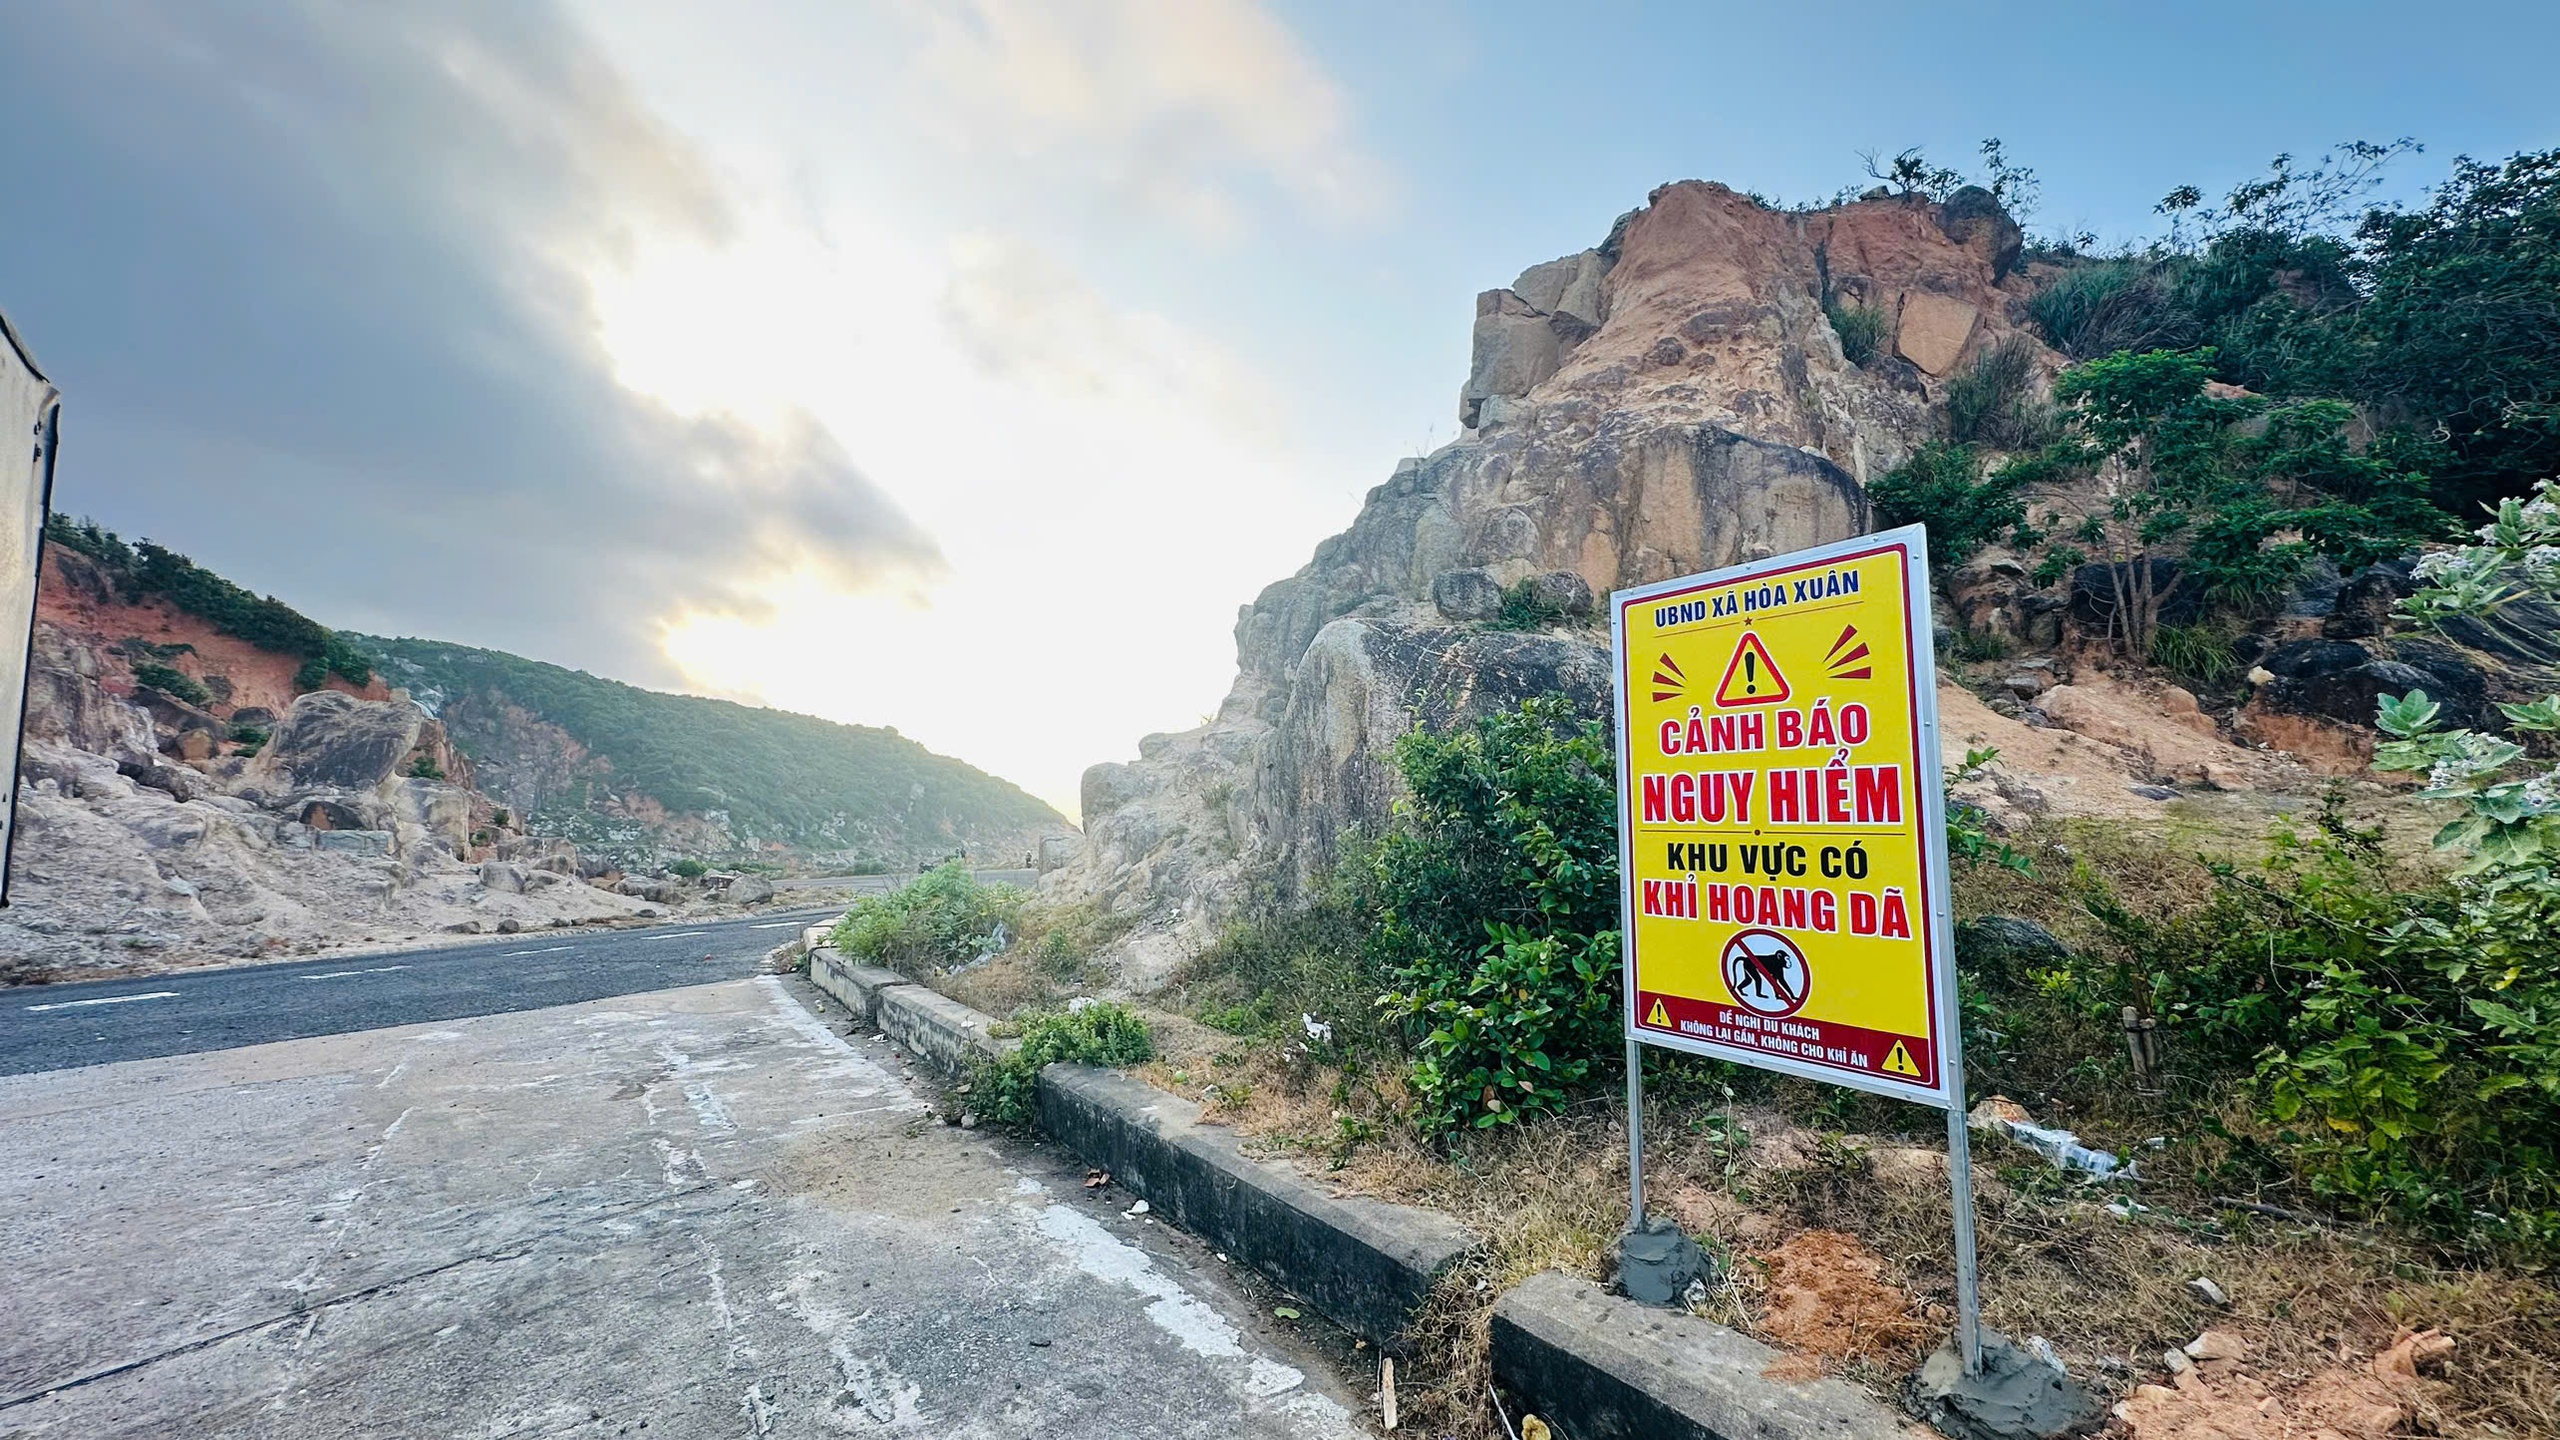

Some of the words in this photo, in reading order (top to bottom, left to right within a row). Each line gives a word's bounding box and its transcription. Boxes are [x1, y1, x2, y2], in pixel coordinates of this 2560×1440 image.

[1655, 601, 1706, 627] UBND
[1712, 591, 1738, 617] XÃ
[1744, 583, 1786, 611] HÒA
[1794, 570, 1859, 602] XUÂN
[1660, 707, 1764, 755] CẢNH
[1777, 698, 1868, 749] BÁO
[1642, 772, 1754, 823] NGUY
[1768, 749, 1902, 823] HIỂM
[1668, 842, 1728, 873] KHU
[1740, 842, 1806, 881] VỰC
[1820, 840, 1868, 880] CÓ
[1643, 873, 1697, 918] KHỈ
[1708, 885, 1836, 933] HOANG
[1850, 887, 1910, 938] DÃ
[1680, 1019, 1713, 1037] KHÔNG
[1715, 1026, 1731, 1042] LẠI
[1760, 1034, 1798, 1053] KHÔNG
[1801, 1042, 1824, 1059] CHO
[1827, 1046, 1847, 1064] KHỈ
[1850, 1050, 1868, 1068] ĂN
[1735, 1014, 1760, 1032] NGHỊ
[1763, 1019, 1778, 1033] DU
[1781, 1022, 1820, 1041] KHÁCH
